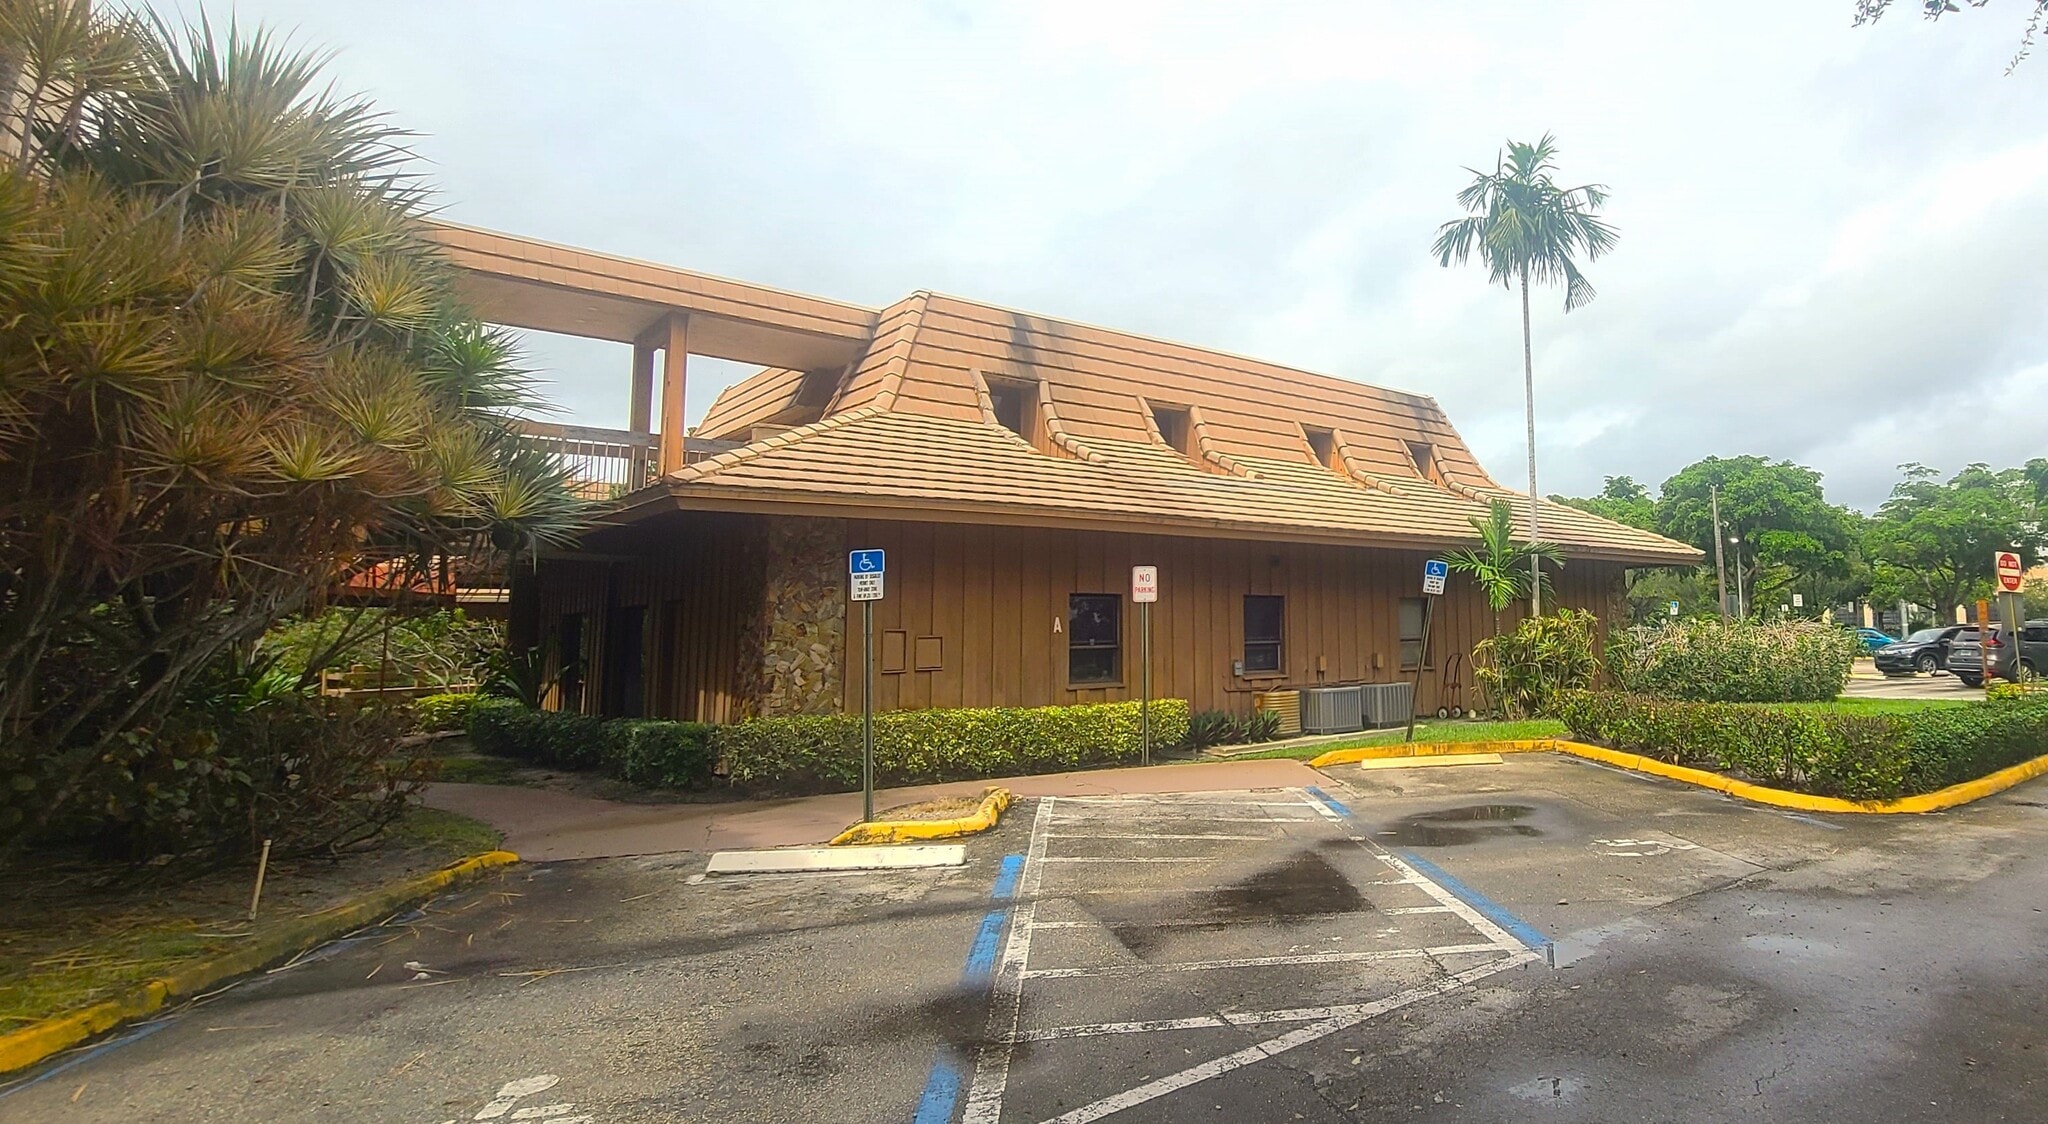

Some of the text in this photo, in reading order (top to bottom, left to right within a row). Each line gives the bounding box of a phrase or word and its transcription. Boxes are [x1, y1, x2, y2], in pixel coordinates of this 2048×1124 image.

[1139, 573, 1150, 582] NO
[2003, 576, 2018, 584] ENTER
[1053, 616, 1063, 633] A
